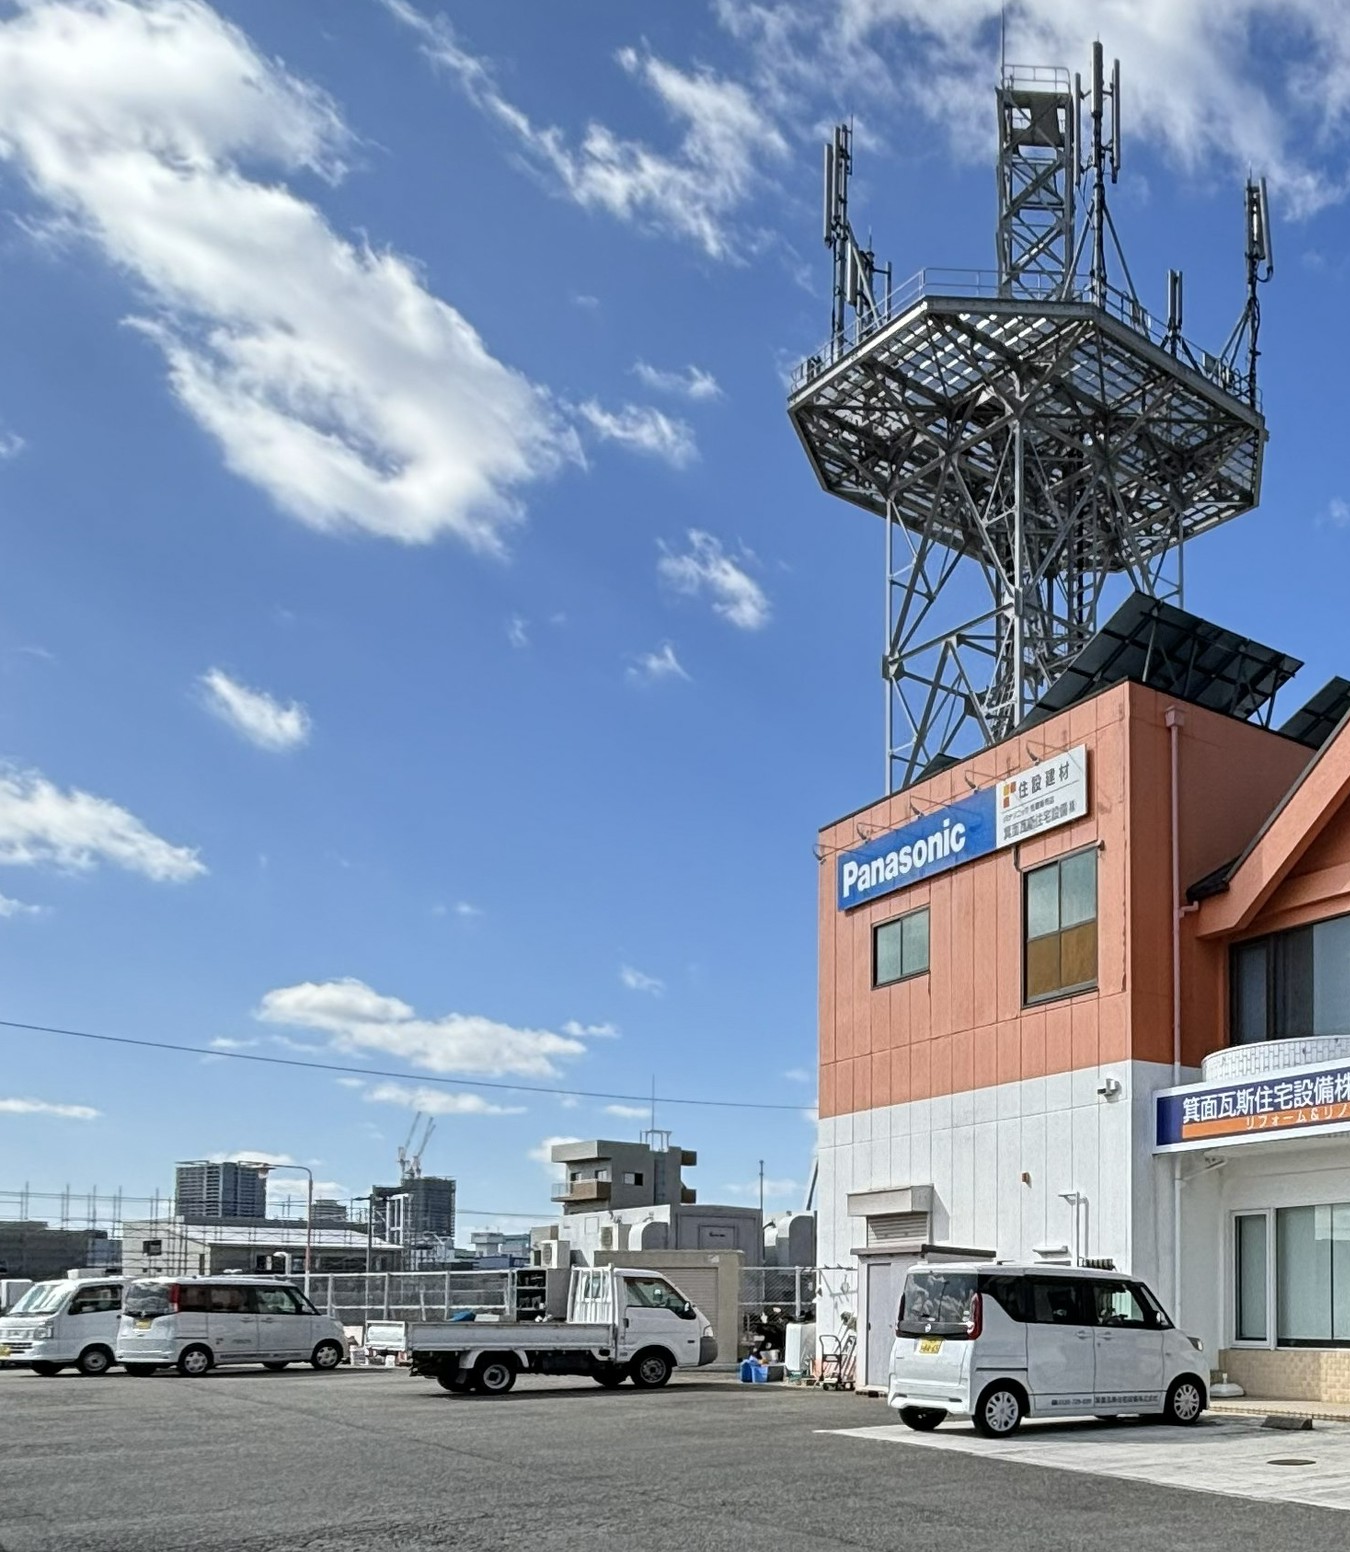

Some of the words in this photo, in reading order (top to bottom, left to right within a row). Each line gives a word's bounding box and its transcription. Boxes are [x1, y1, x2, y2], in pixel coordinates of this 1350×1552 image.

[1018, 761, 1070, 799] 住設建材
[843, 818, 967, 898] Panasonic
